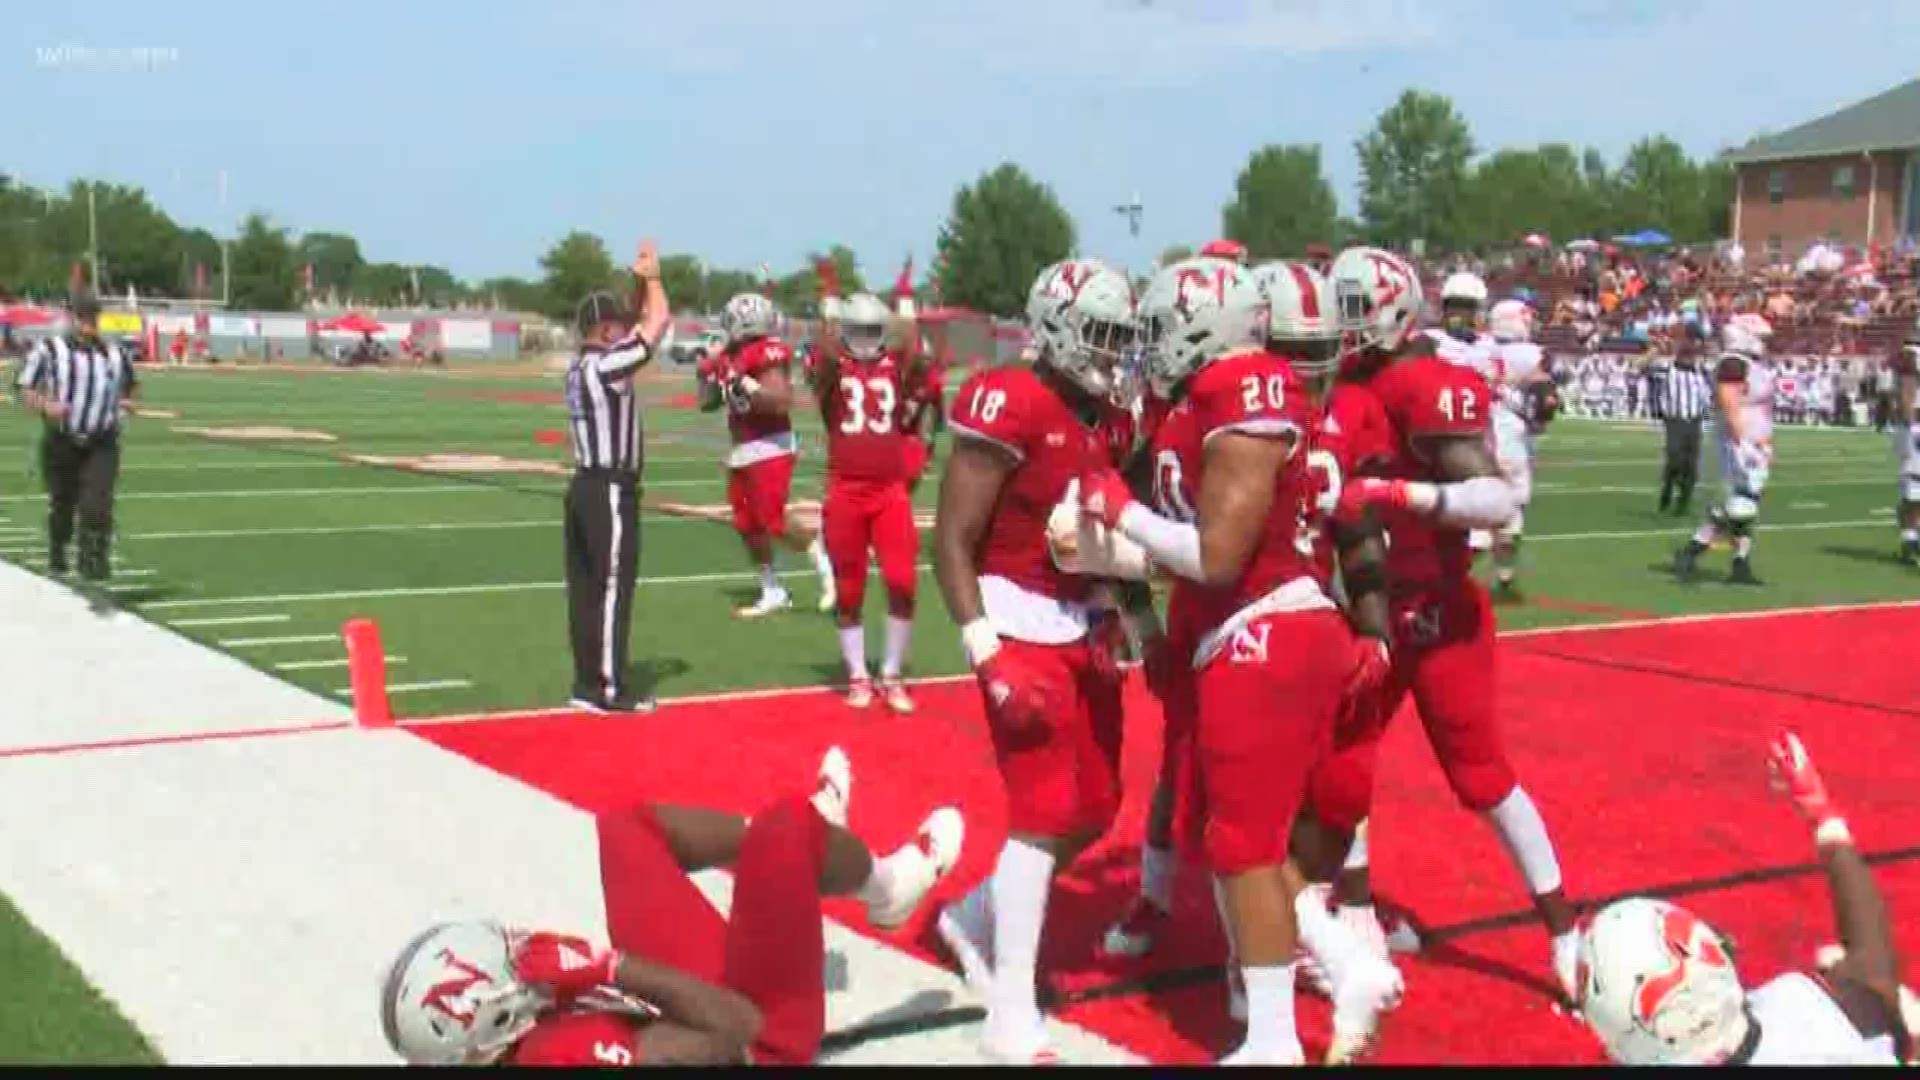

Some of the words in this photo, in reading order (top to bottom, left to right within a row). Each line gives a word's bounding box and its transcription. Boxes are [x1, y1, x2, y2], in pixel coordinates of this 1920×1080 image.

[840, 376, 896, 434] 33
[969, 384, 1006, 423] 18
[1240, 374, 1285, 412] 20
[1437, 386, 1477, 421] 42
